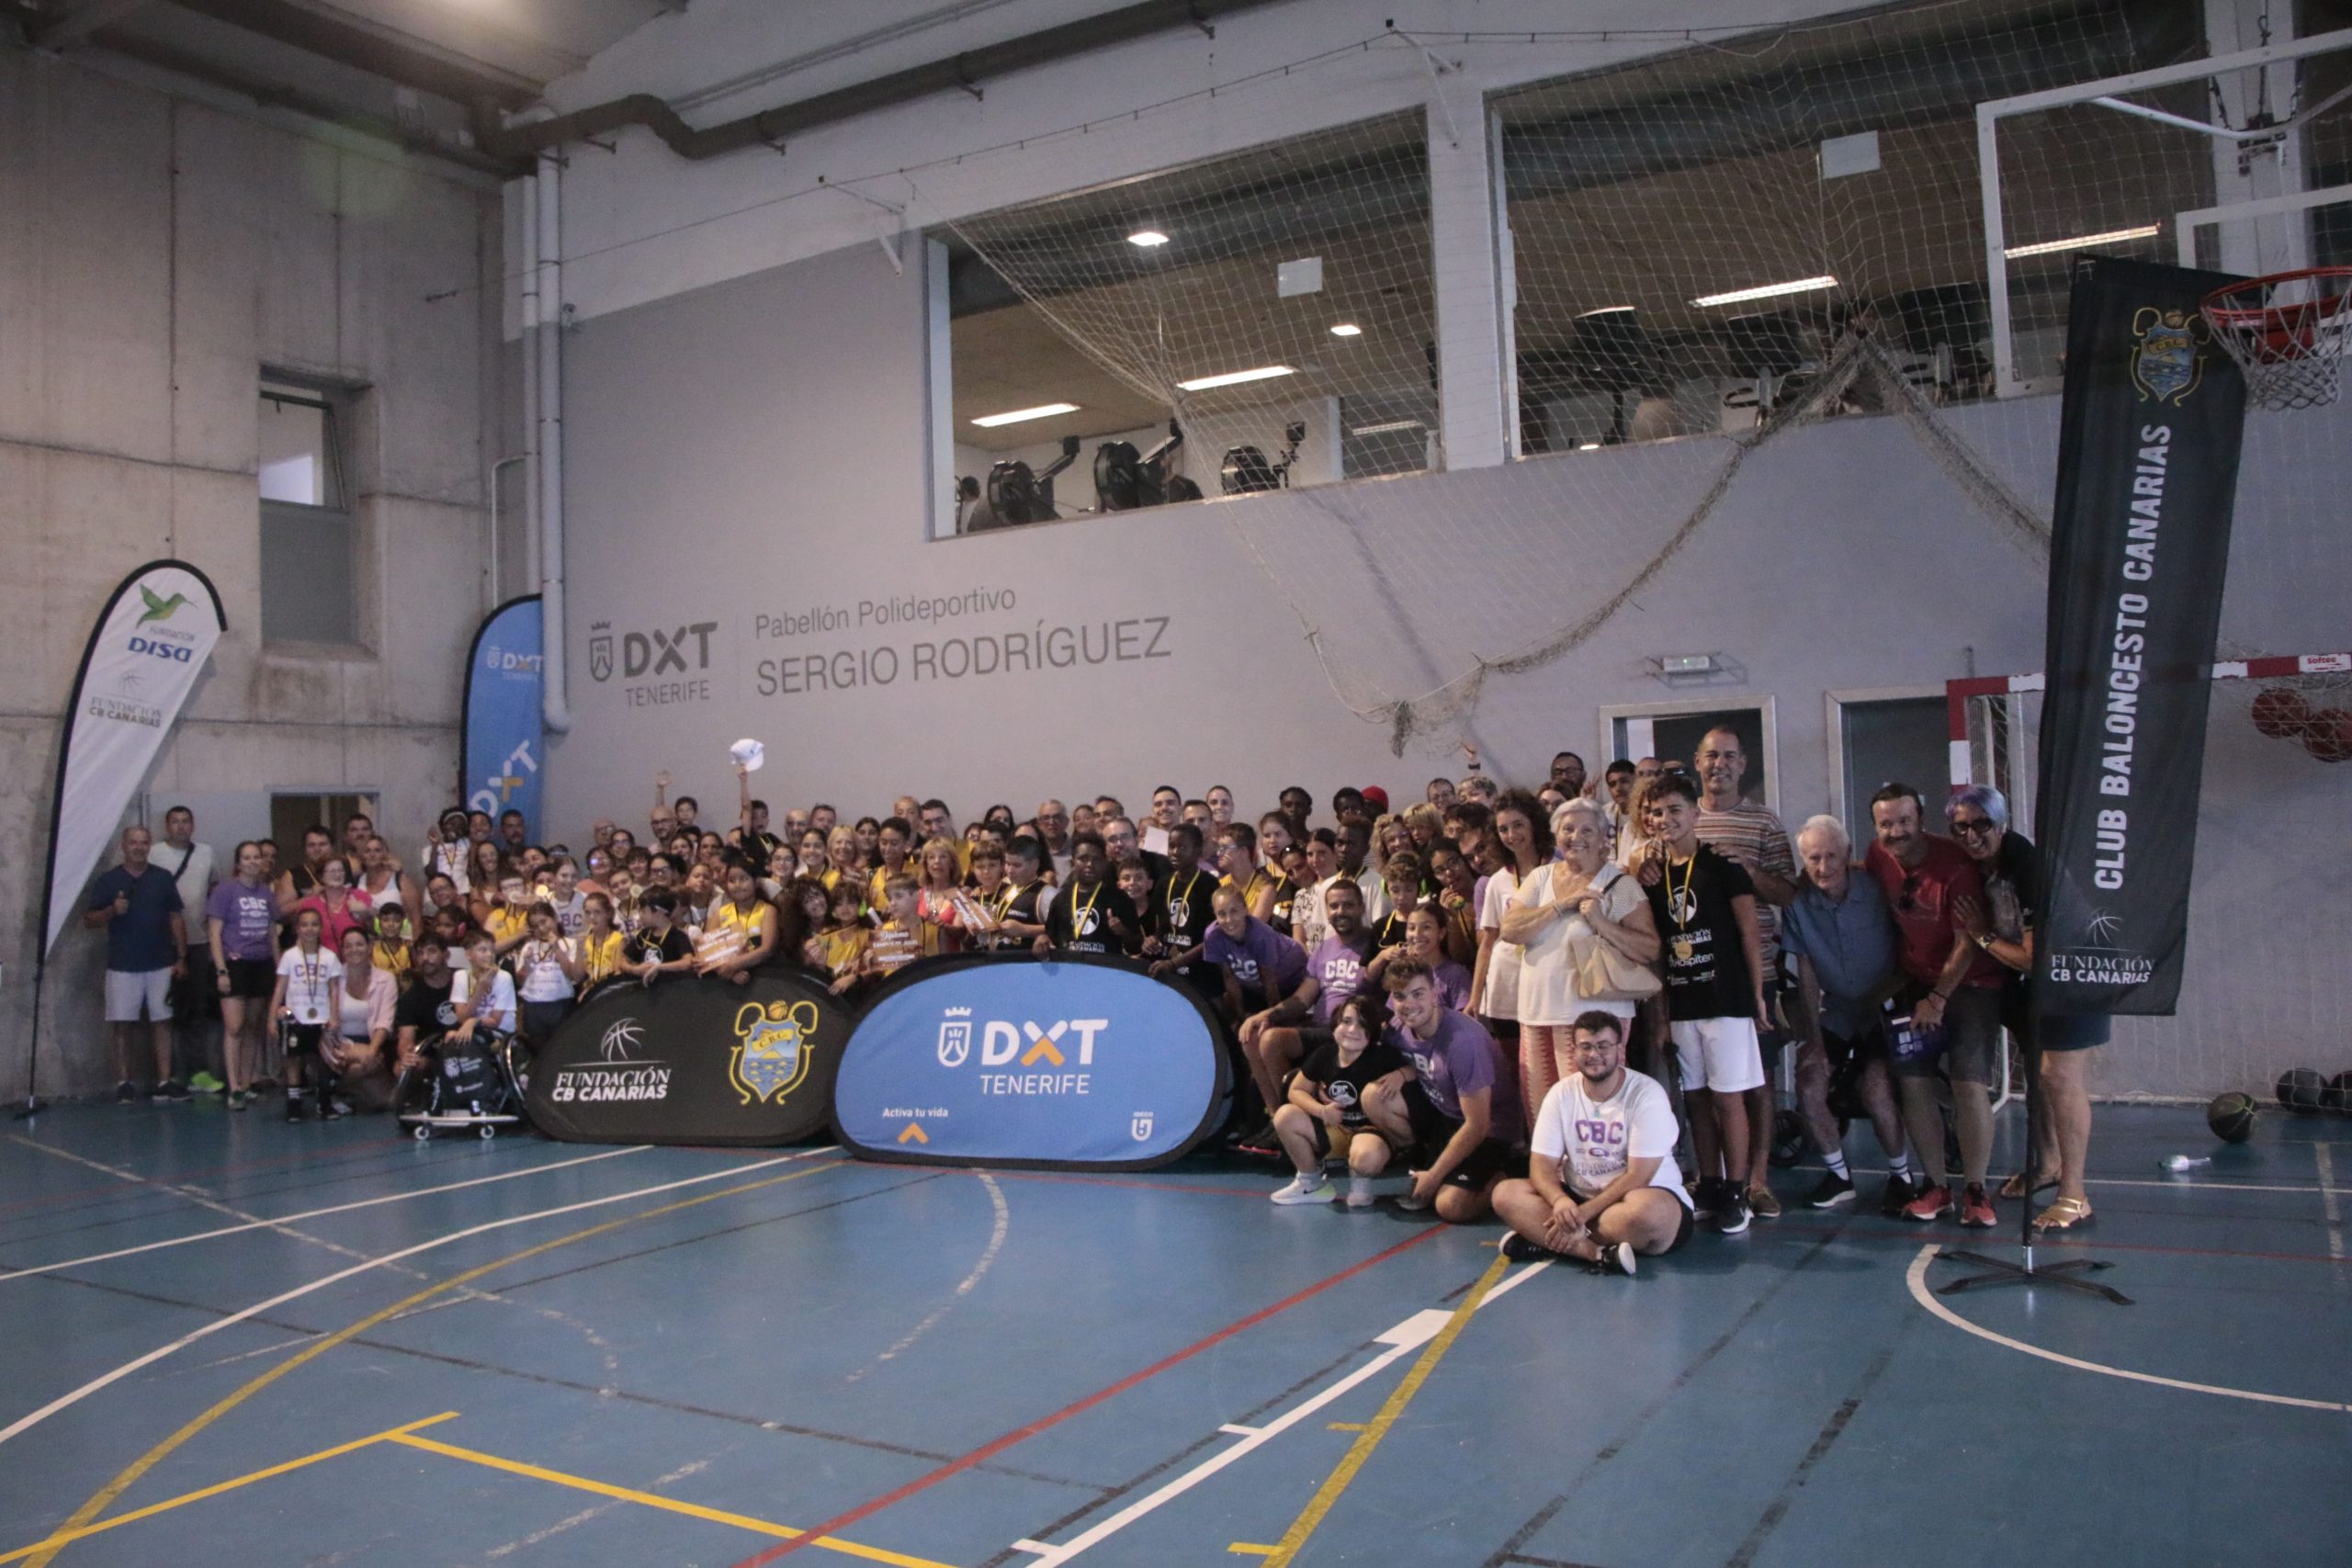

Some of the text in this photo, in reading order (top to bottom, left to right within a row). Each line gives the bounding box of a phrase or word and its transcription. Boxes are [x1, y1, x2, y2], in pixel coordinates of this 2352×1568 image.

[755, 586, 1016, 639] Pabellón Polideportivo
[624, 621, 718, 678] DXT
[757, 618, 1172, 697] SERGIO RODRÍGUEZ
[2094, 424, 2172, 890] CLUB BALONCESTO CANARIAS
[625, 680, 710, 706] TENERIFE
[1325, 959, 1360, 979] CBC
[2051, 953, 2155, 972] FUNDACIÓN
[2051, 969, 2151, 985] CB CANARIAS
[981, 1019, 1109, 1066] DXT
[557, 1066, 672, 1087] FUNDACIÓN
[980, 1074, 1091, 1094] TENERIFE
[552, 1084, 667, 1101] CB CANARIAS
[882, 1106, 948, 1118] Activa tu vida
[1575, 1120, 1623, 1145] CBC
